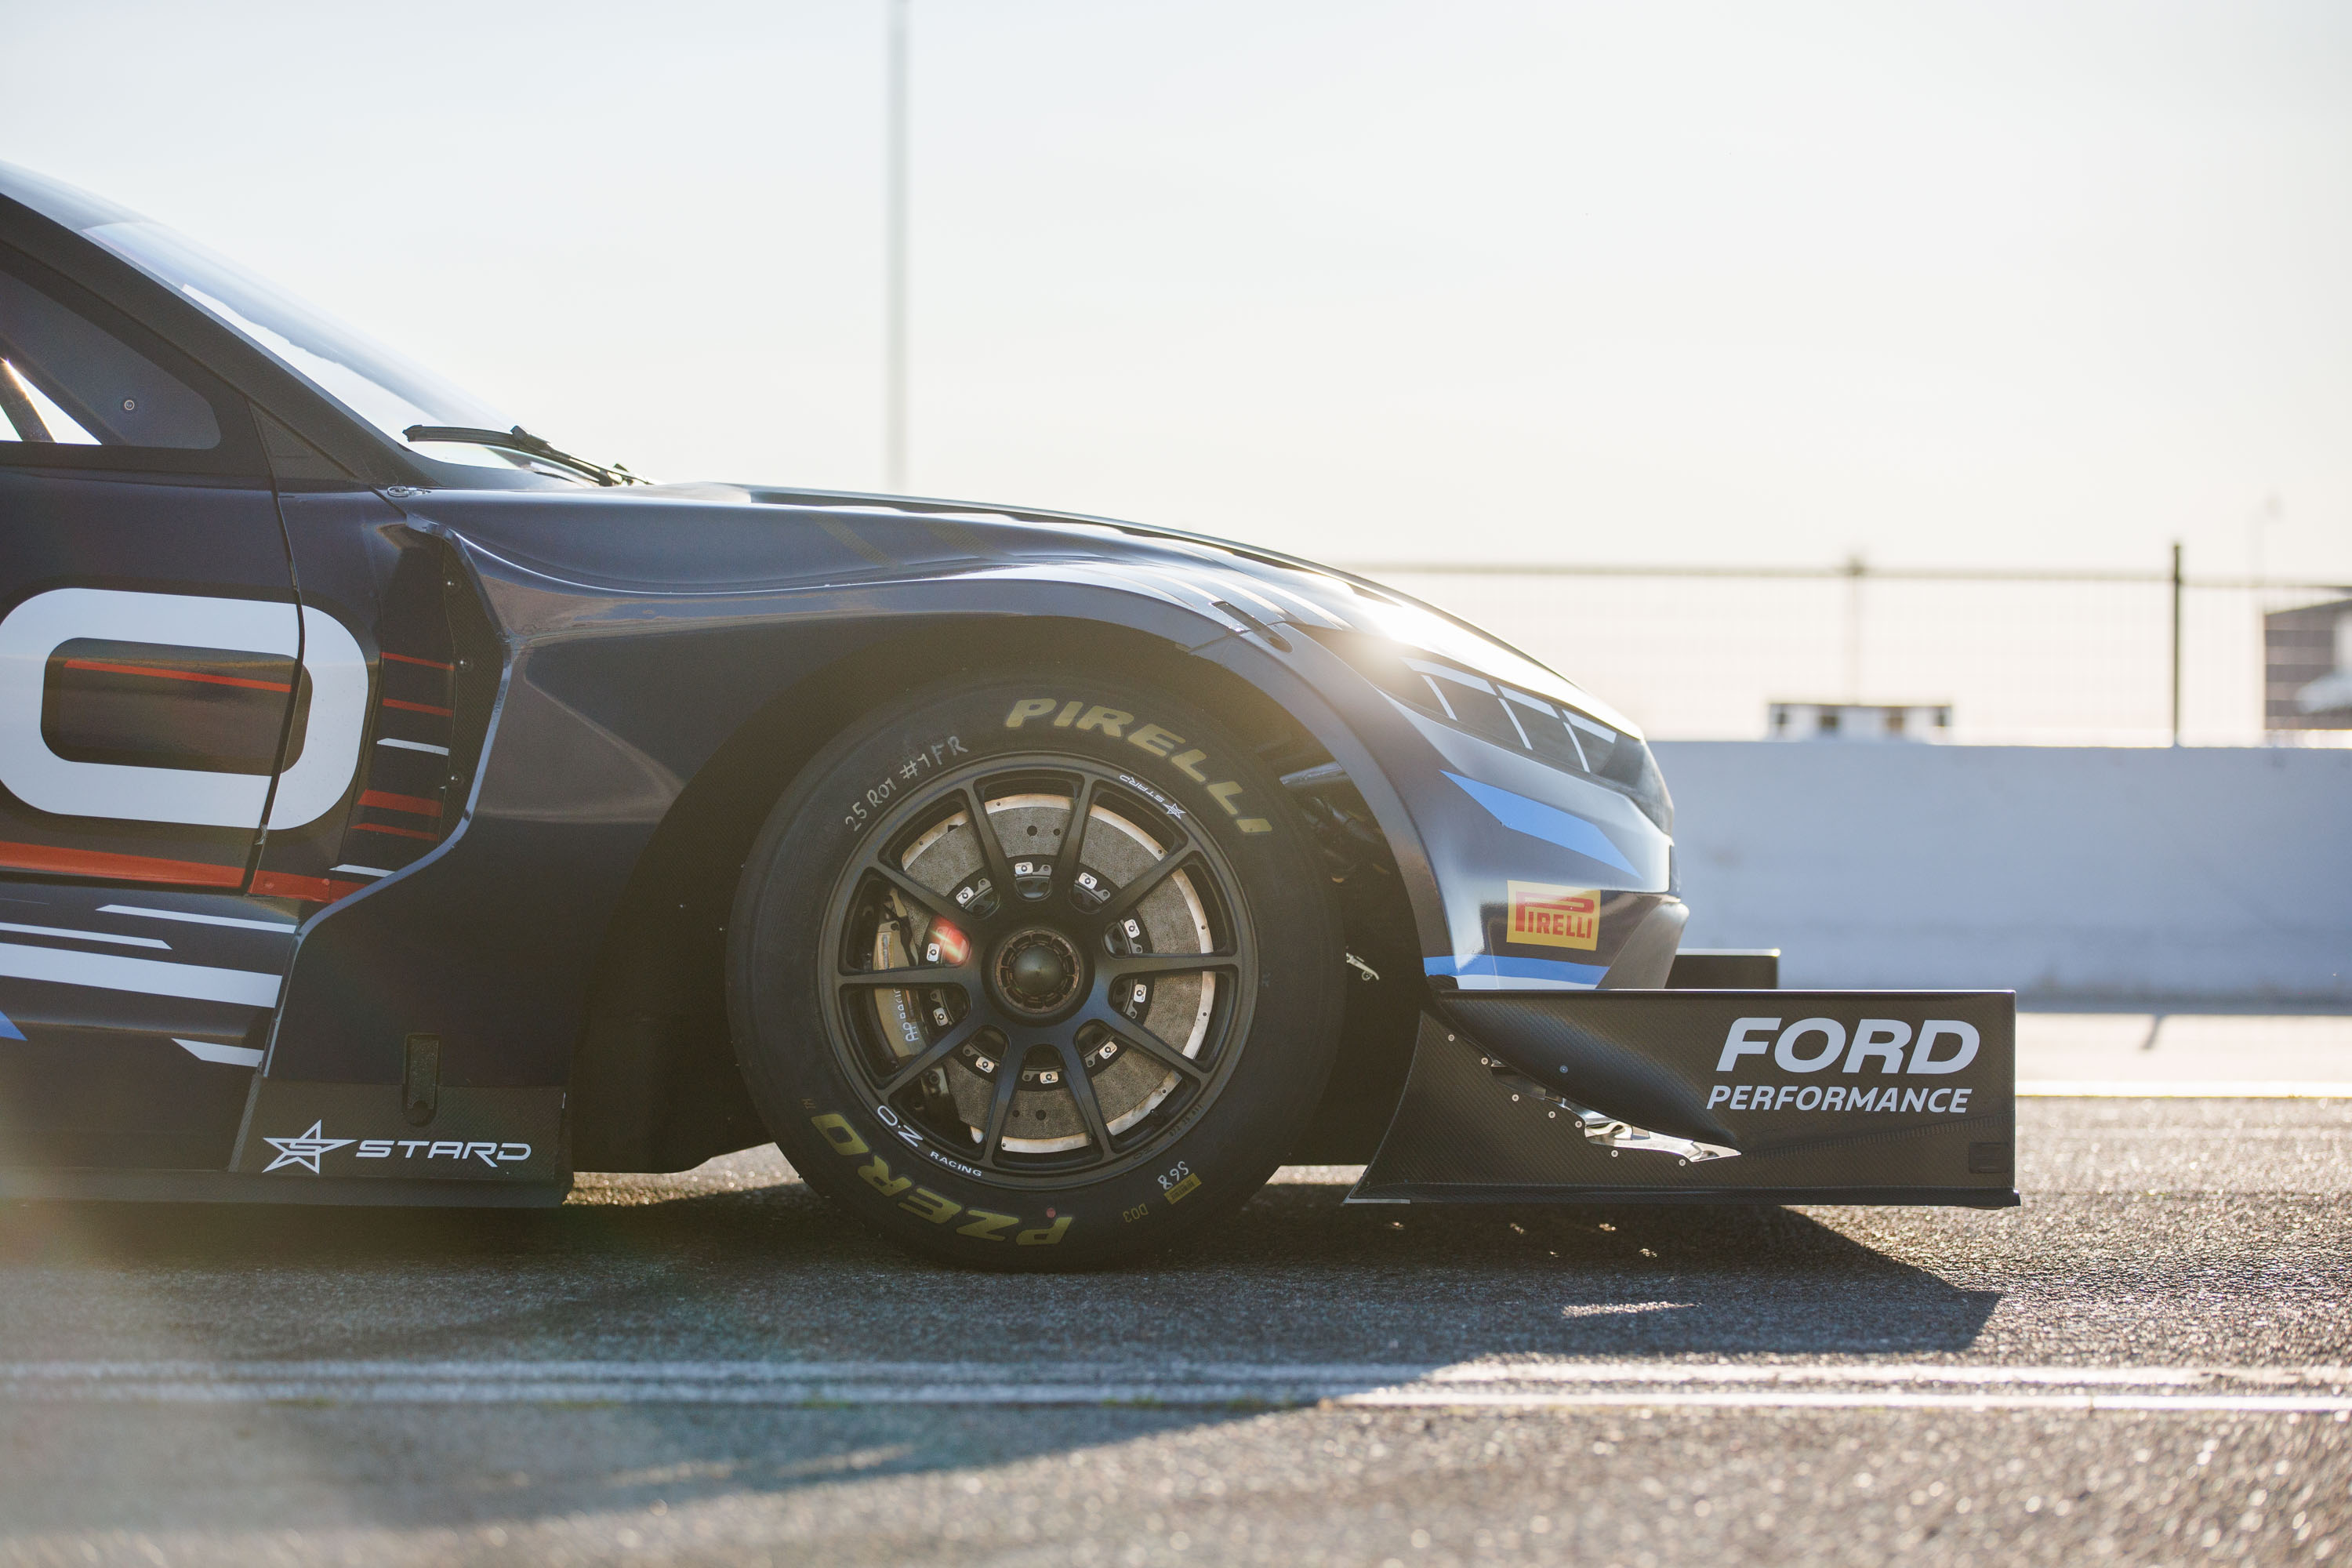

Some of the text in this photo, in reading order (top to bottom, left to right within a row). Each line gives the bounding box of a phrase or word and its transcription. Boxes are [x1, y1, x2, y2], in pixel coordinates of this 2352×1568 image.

[1006, 698, 1272, 833] PIRELLI
[845, 801, 867, 832] 25
[1515, 891, 1595, 939] PIRELLI
[1715, 1017, 1980, 1074] FORD
[1706, 1085, 1973, 1113] PERFORMANCE
[355, 1140, 532, 1167] STARD
[930, 1151, 982, 1177] RACING
